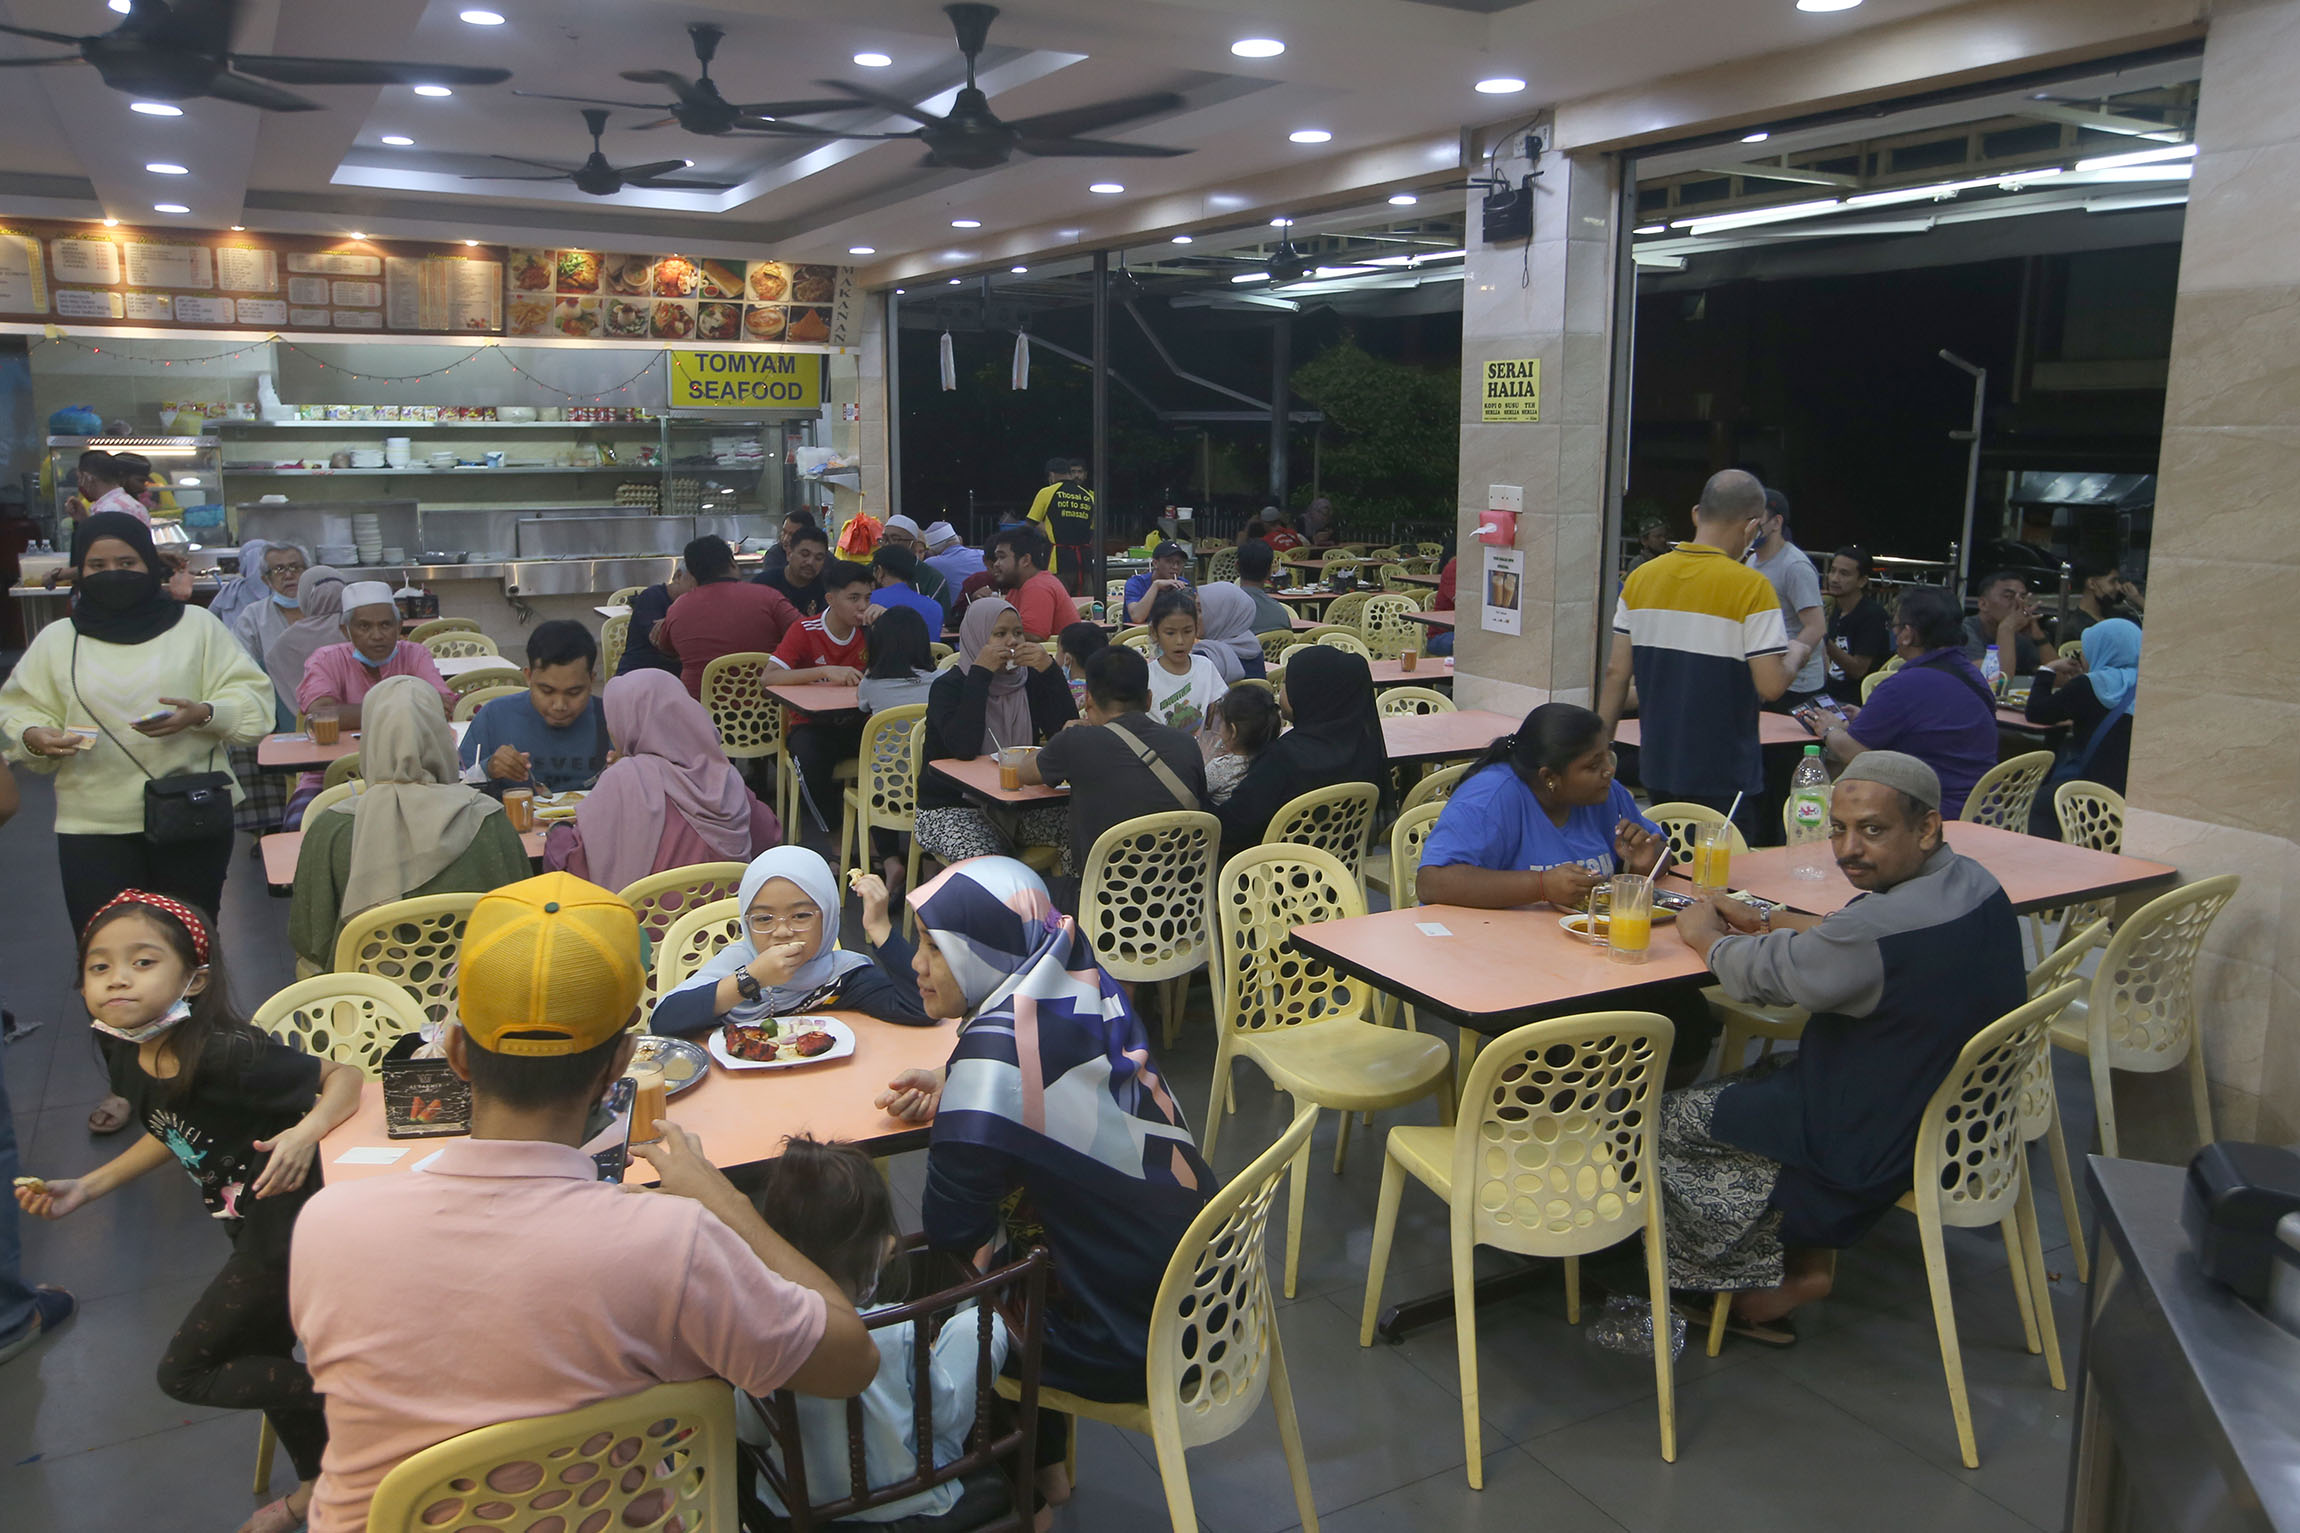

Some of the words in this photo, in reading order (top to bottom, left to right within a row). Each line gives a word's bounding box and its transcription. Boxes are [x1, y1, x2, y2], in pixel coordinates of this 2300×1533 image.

[834, 266, 855, 343] MAKANAN
[695, 353, 796, 374] TOMYAM
[1488, 361, 1534, 379] SERAI
[688, 380, 803, 401] SEAFOOD
[1488, 381, 1535, 398] HALIA
[1070, 501, 1079, 509] to
